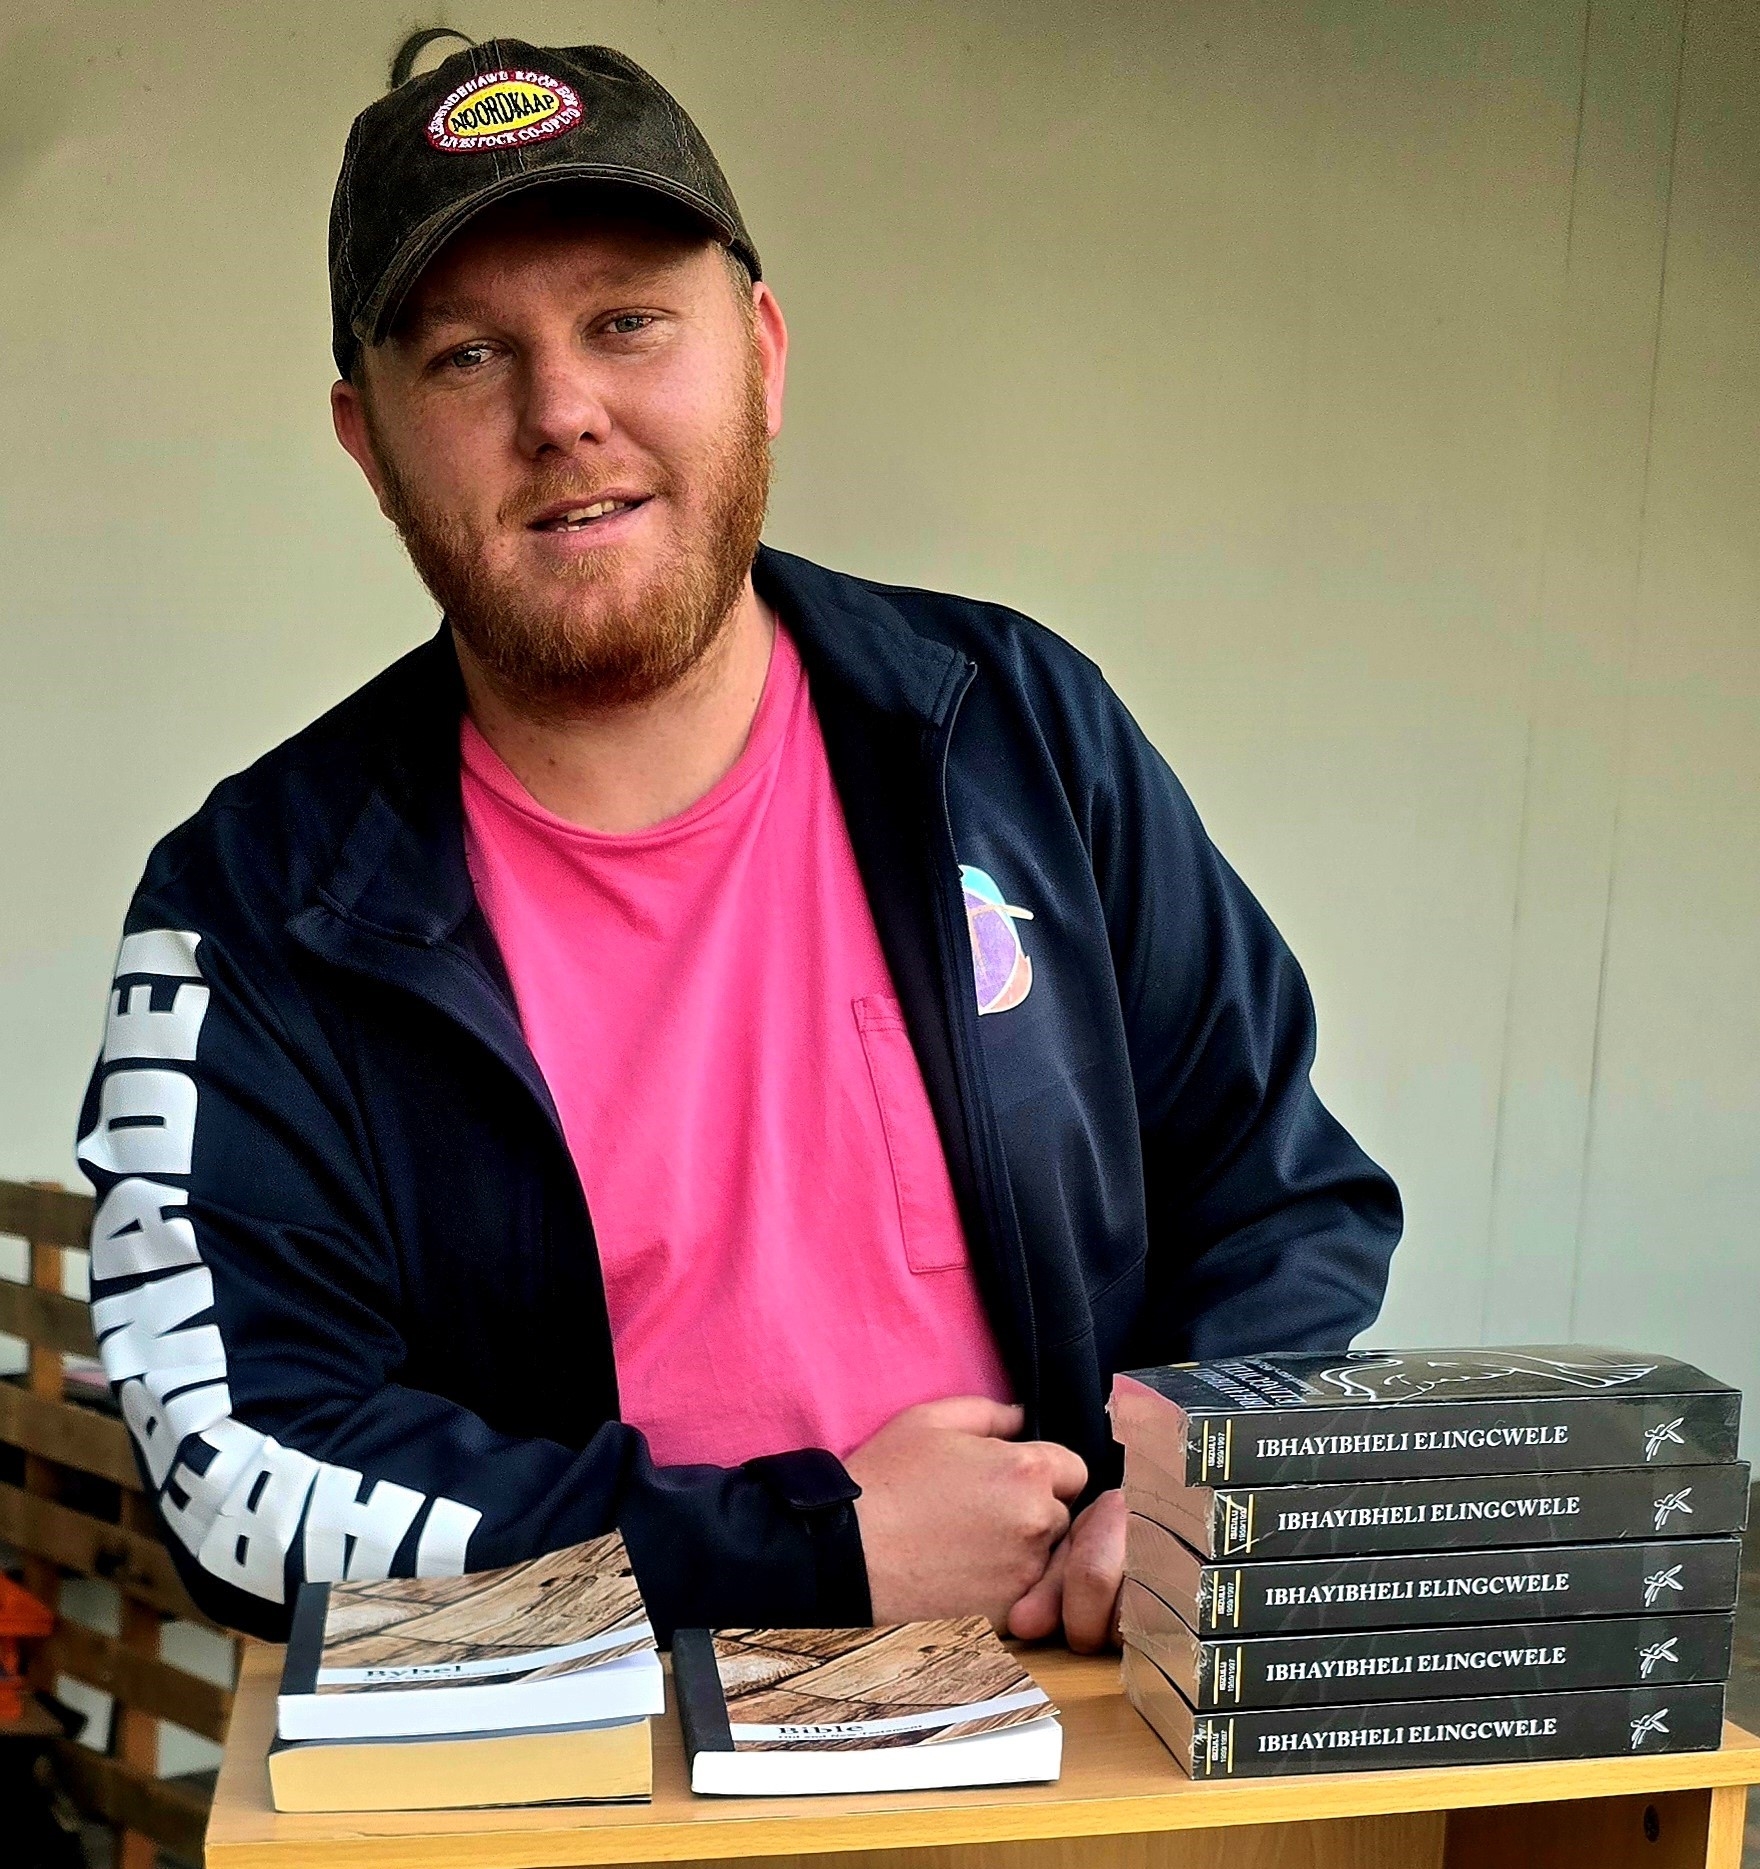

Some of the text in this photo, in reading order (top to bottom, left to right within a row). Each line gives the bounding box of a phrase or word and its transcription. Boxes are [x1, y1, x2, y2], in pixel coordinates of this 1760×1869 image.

[515, 71, 559, 89] KOOP
[450, 92, 555, 132] NOORDKAAP
[439, 132, 517, 149] LIVESTOCK
[517, 118, 561, 141] CO-OP
[1257, 1425, 1569, 1457] IBHAYIBHELI ELINGCWELE
[1278, 1497, 1581, 1530] IBHAYIBHELI ELINGCWELE
[1266, 1573, 1570, 1605] IBHAYIBHELI ELINGCWELE
[367, 1665, 461, 1678] Bybel
[1266, 1647, 1567, 1681] IBHAYIBHELI ELINGCWELE
[777, 1725, 864, 1734] Bible
[1258, 1718, 1557, 1752] IBHAYIBHELI ELINGCWELE
